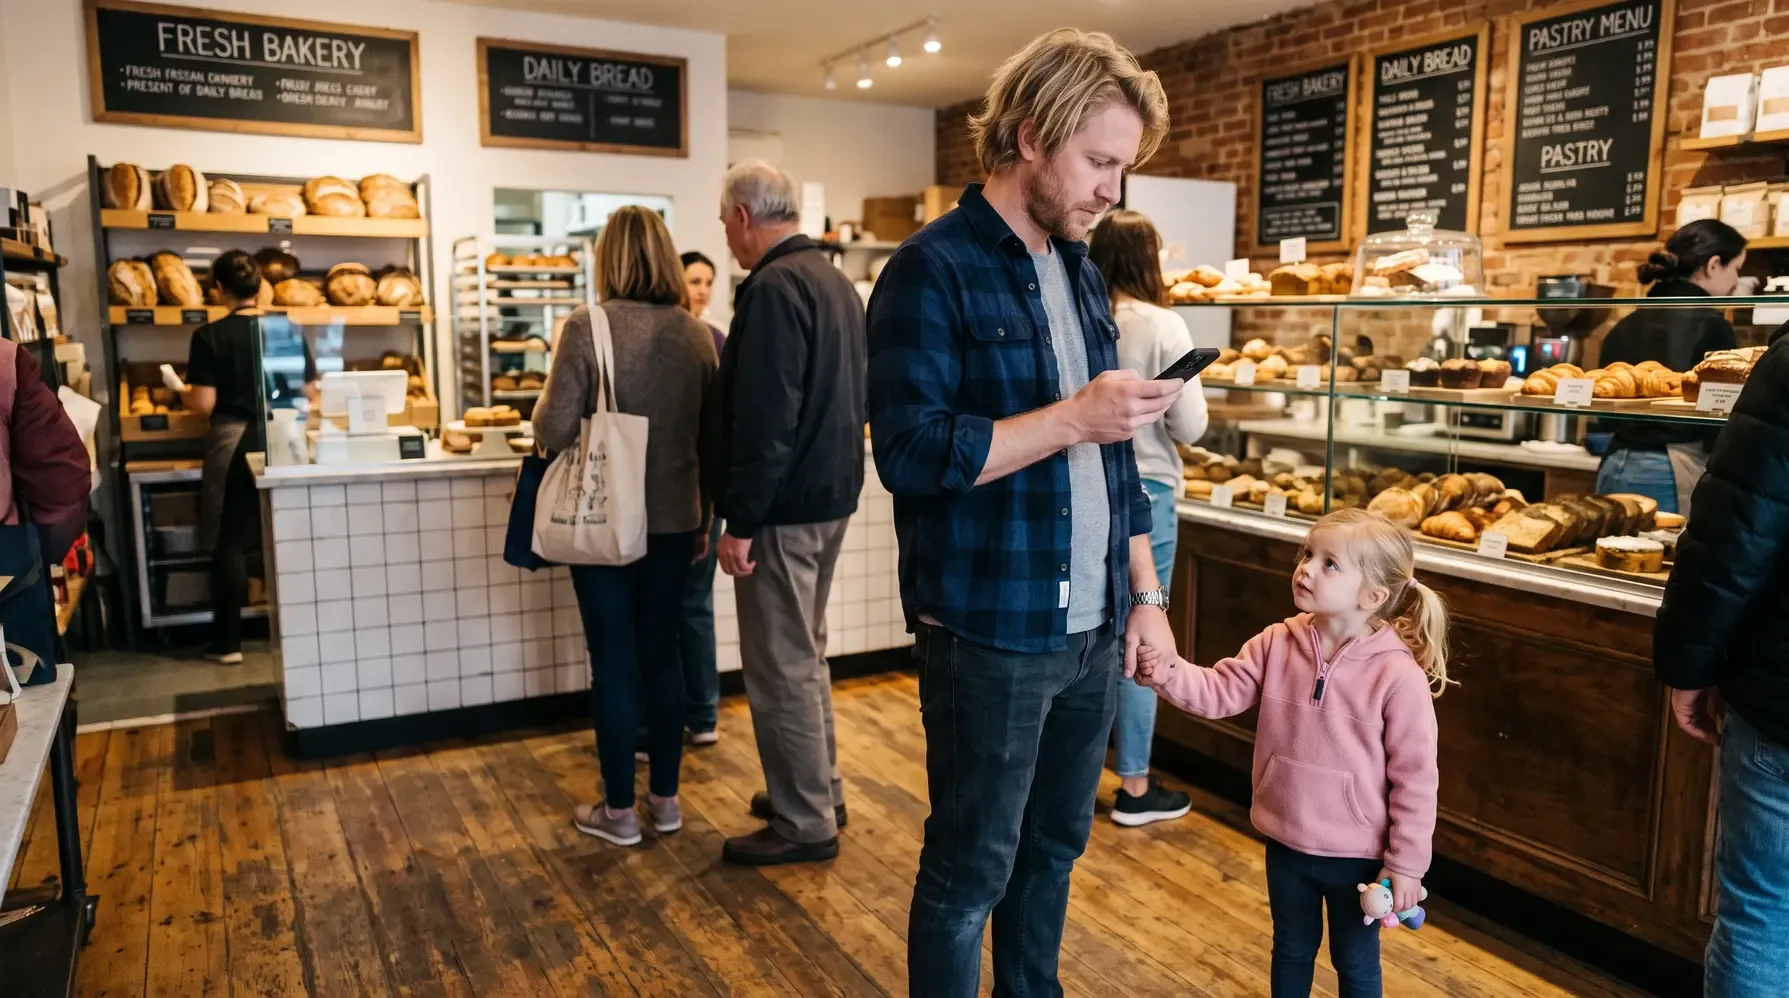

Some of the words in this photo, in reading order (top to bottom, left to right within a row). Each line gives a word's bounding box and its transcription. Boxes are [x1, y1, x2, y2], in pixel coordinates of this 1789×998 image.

[1530, 17, 1595, 50] PASTRY
[1600, 5, 1652, 37] MENU
[157, 22, 250, 60] FRESH
[263, 33, 365, 69] BAKERY
[1381, 54, 1421, 80] DAILY
[1423, 45, 1472, 71] BREAD
[524, 56, 582, 83] DAILY
[591, 63, 653, 89] BREAD
[1267, 81, 1299, 101] FRESH
[1302, 71, 1346, 96] BAKERY
[1541, 138, 1613, 168] PASTRY
